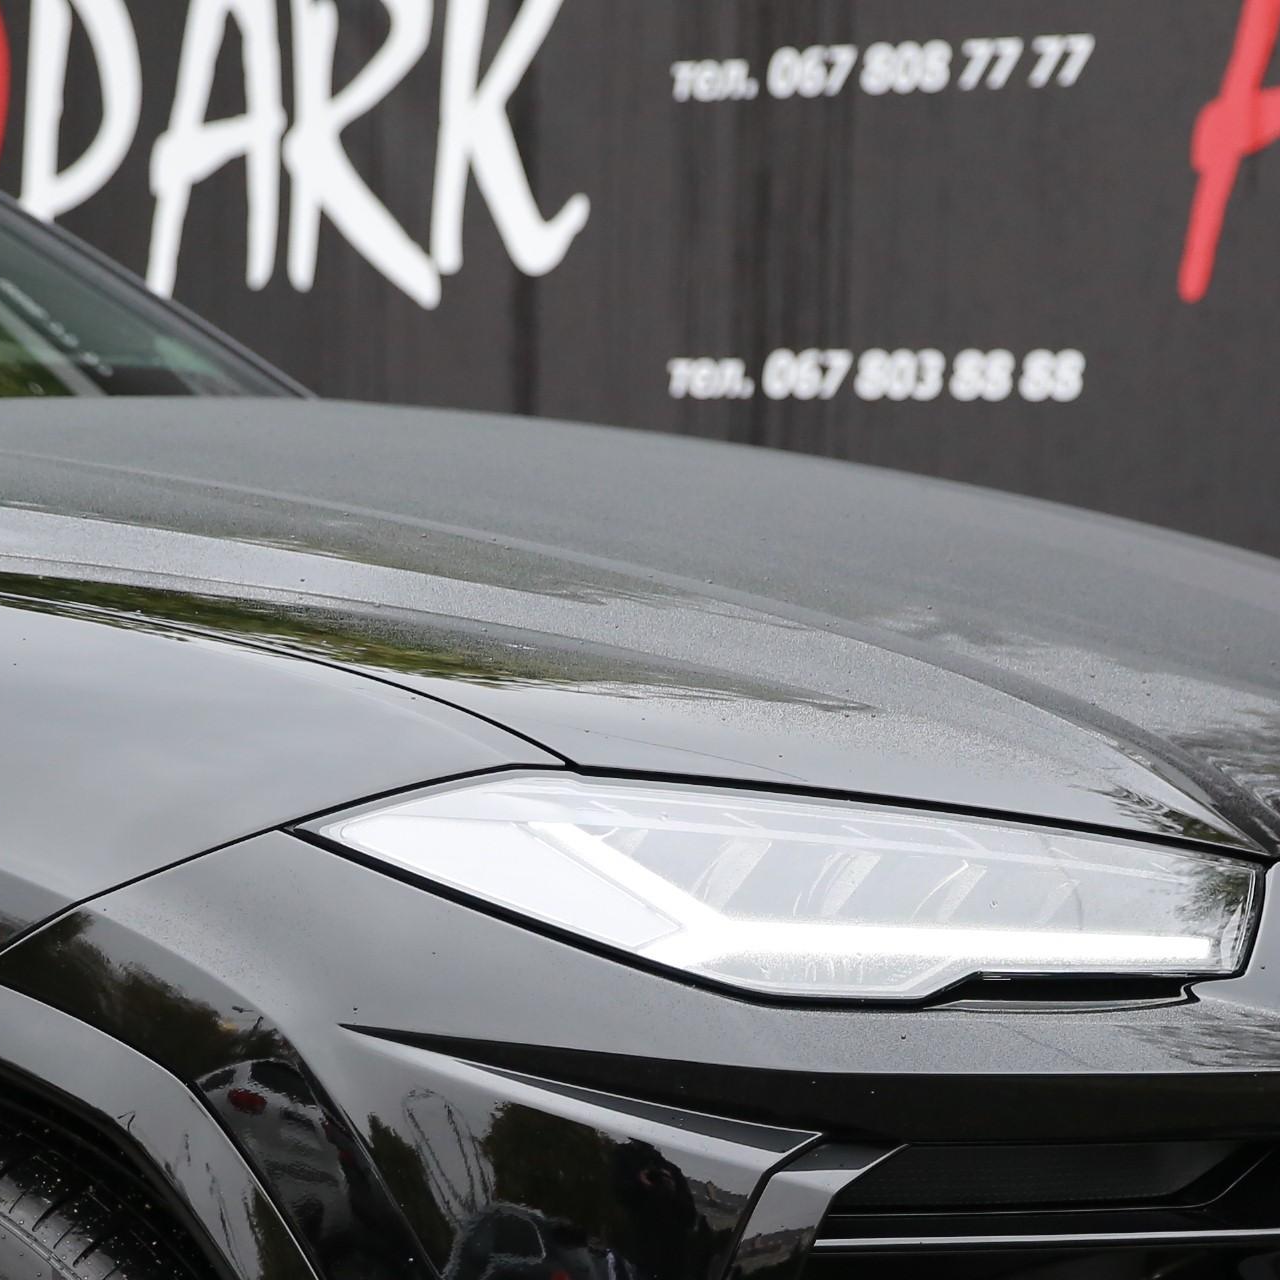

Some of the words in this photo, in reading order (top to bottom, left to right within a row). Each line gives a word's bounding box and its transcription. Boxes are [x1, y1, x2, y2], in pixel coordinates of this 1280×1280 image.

[671, 58, 759, 103] тел.
[766, 45, 858, 99] 067
[957, 36, 1025, 92] 77
[1028, 33, 1096, 89] 77
[666, 357, 755, 400] тел.
[761, 348, 853, 401] 067
